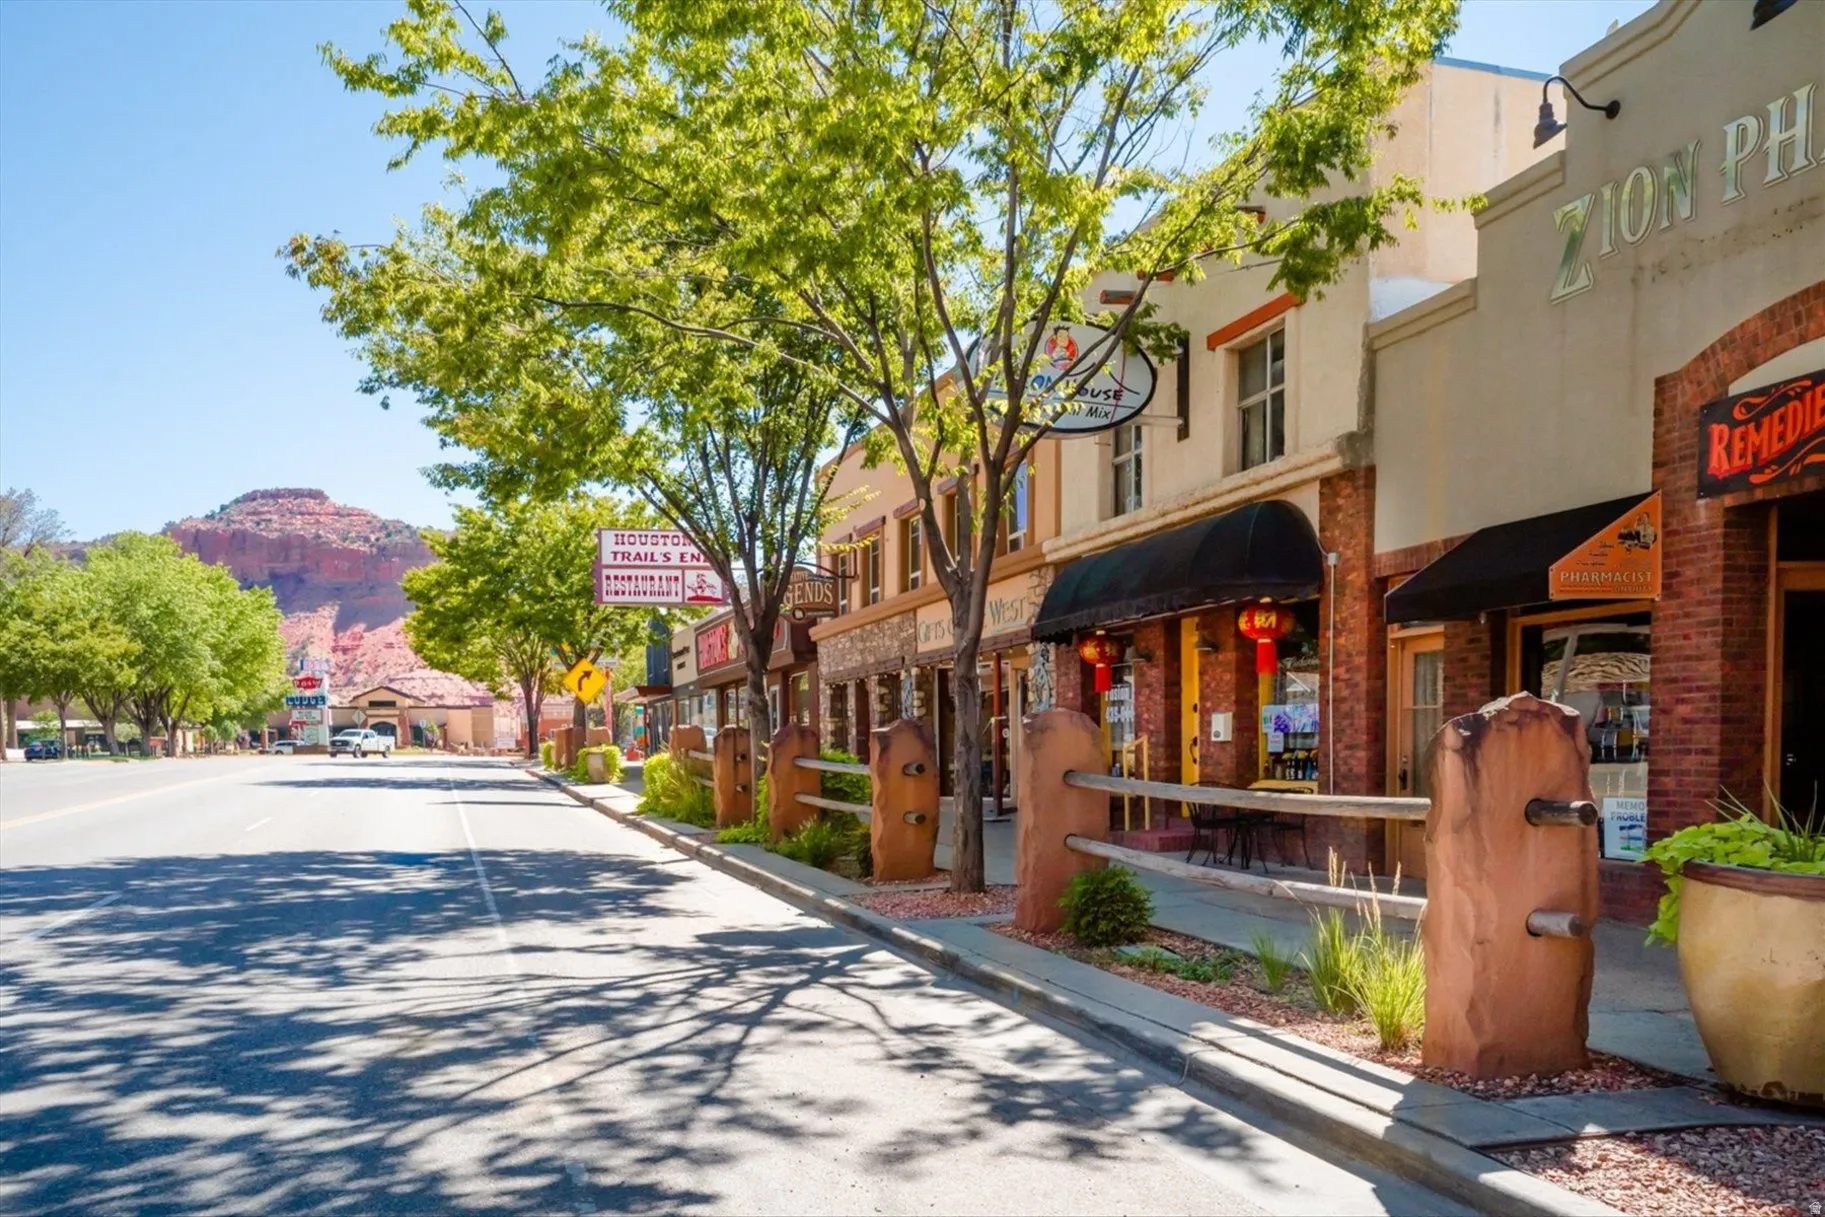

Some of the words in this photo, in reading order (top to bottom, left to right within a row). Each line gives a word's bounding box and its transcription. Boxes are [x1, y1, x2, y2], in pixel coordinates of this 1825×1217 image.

[1550, 138, 1701, 305] ZION
[1720, 82, 1825, 207] PH
[1085, 406, 1111, 420] Mix
[611, 551, 671, 563] TRAIL'S
[604, 574, 680, 597] RESTAURANT
[1560, 571, 1653, 586] PHARMACIST
[783, 581, 833, 608] GENDS
[989, 598, 1026, 625] WEST
[1616, 800, 1646, 811] MEMO
